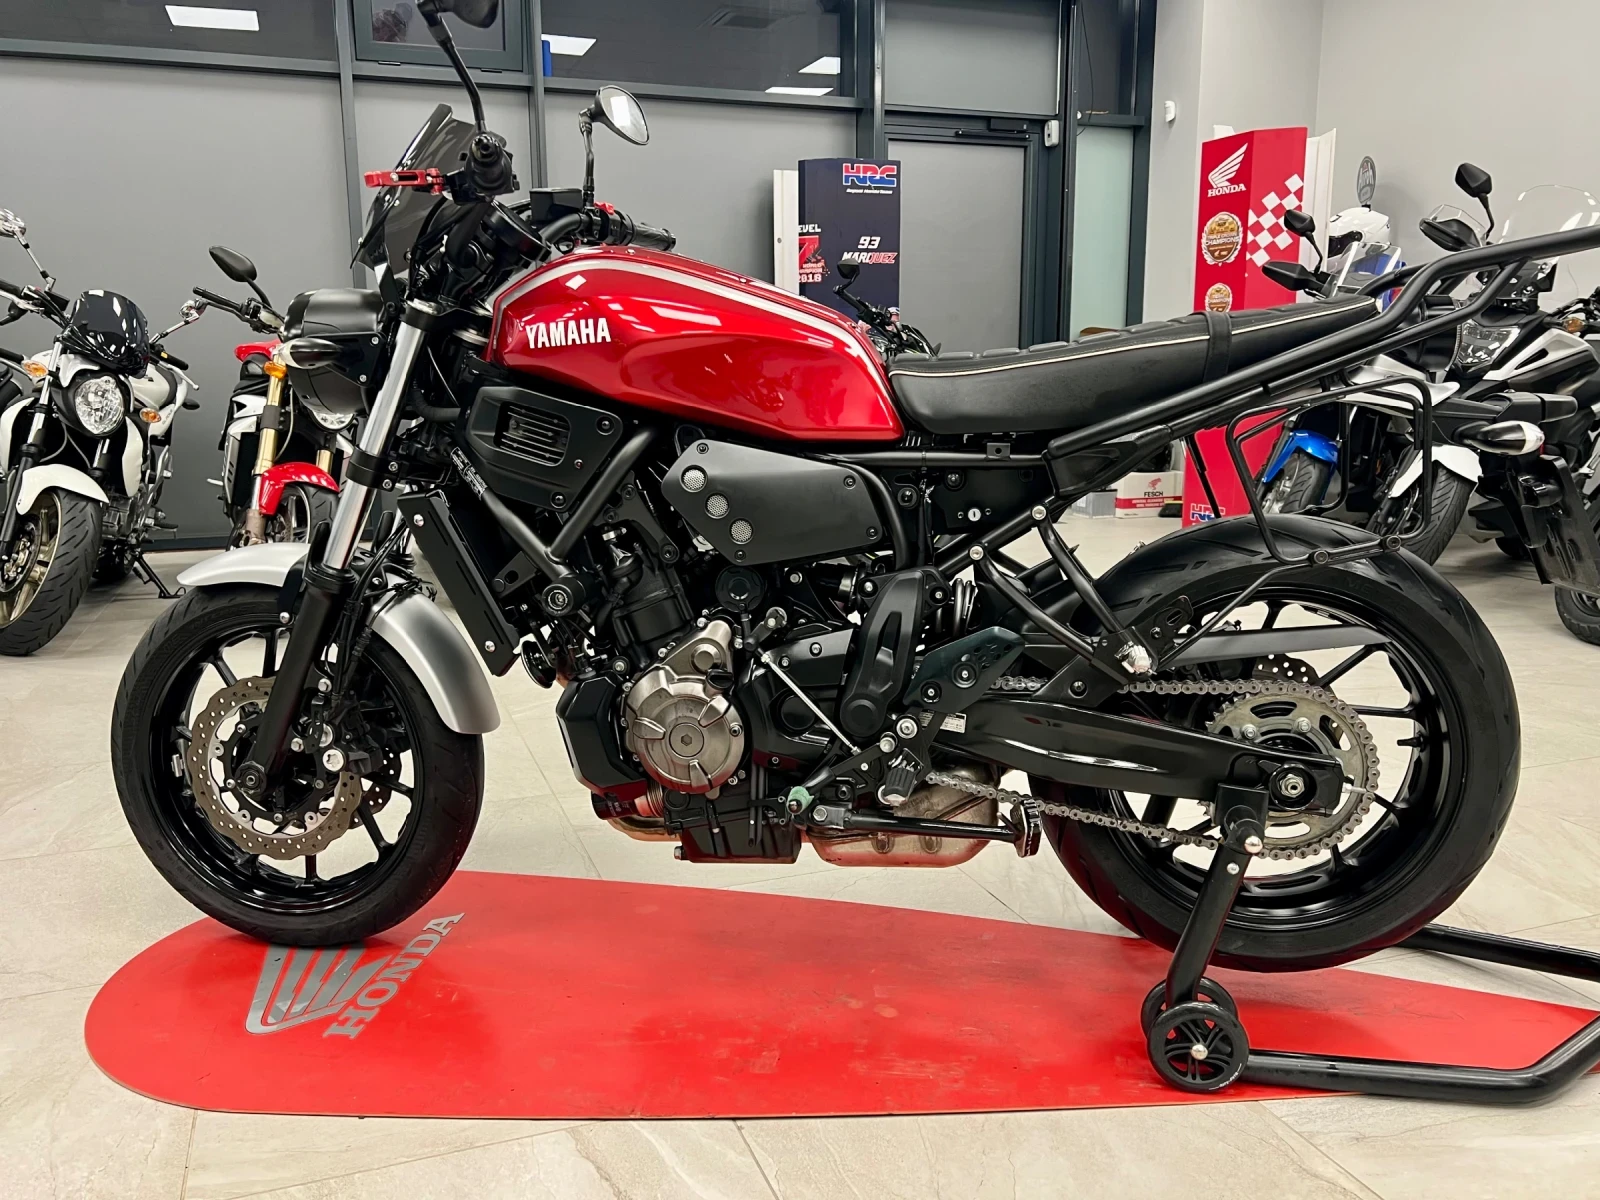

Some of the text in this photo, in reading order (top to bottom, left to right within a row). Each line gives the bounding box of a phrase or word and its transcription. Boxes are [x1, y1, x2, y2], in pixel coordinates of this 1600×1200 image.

[843, 163, 897, 187] HRC
[1208, 183, 1246, 197] HONDA
[858, 236, 881, 249] 93
[525, 317, 612, 349] YAMAHA
[1190, 503, 1226, 523] HR
[322, 912, 466, 1040] HONDA
